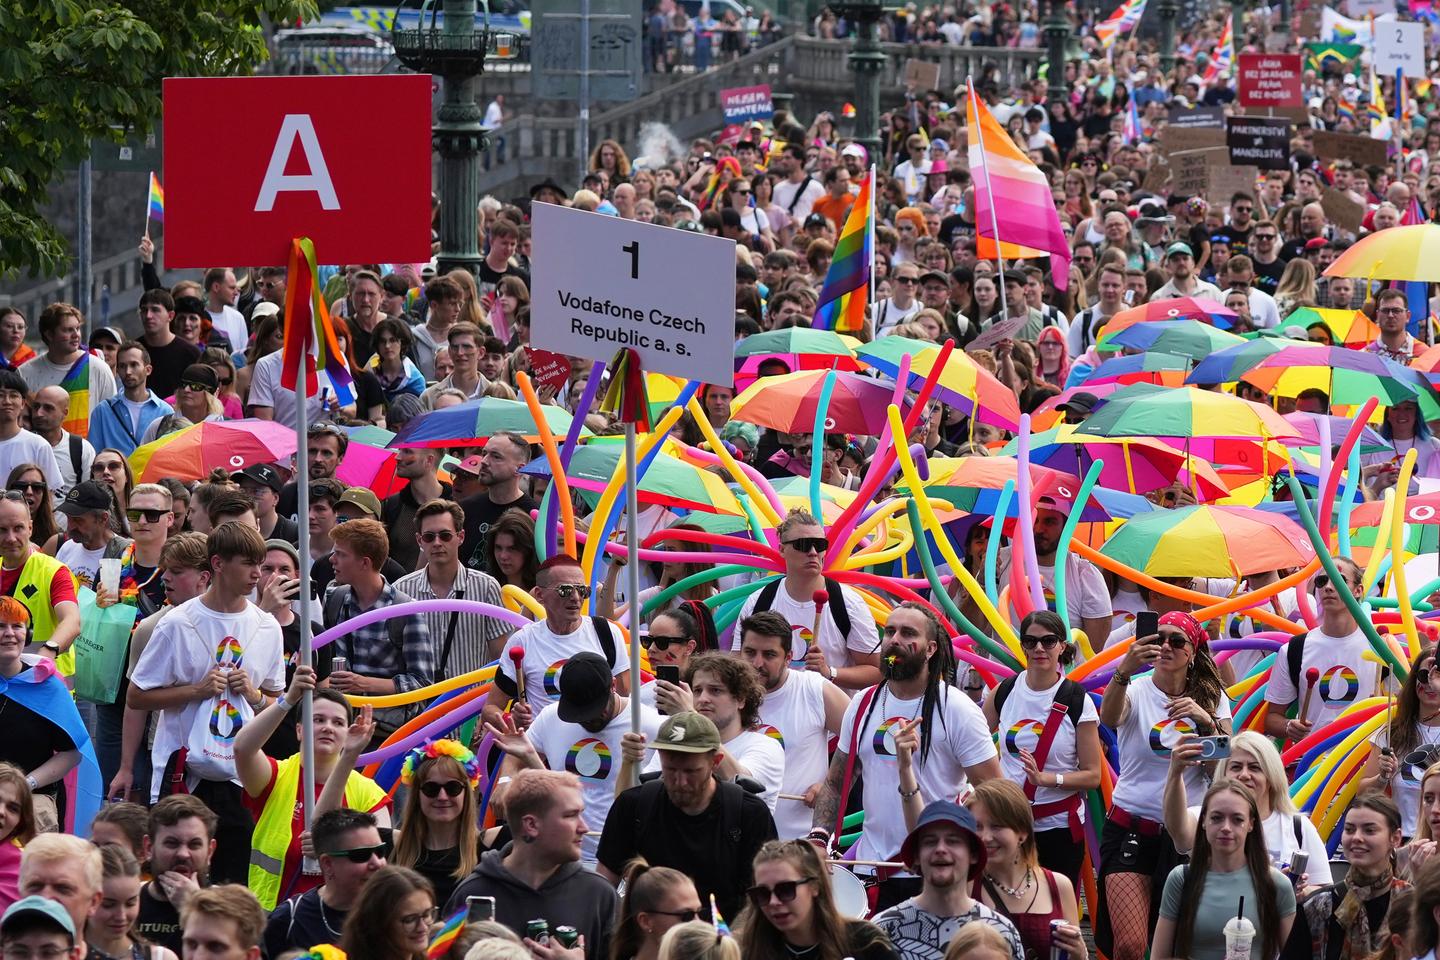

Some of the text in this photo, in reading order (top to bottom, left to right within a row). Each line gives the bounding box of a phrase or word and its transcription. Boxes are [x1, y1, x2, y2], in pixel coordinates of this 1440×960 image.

[1396, 29, 1404, 43] 2
[254, 113, 341, 212] A
[622, 241, 639, 279] 1
[557, 290, 706, 335] Vodafone Czech
[571, 318, 692, 357] Republic a. s.
